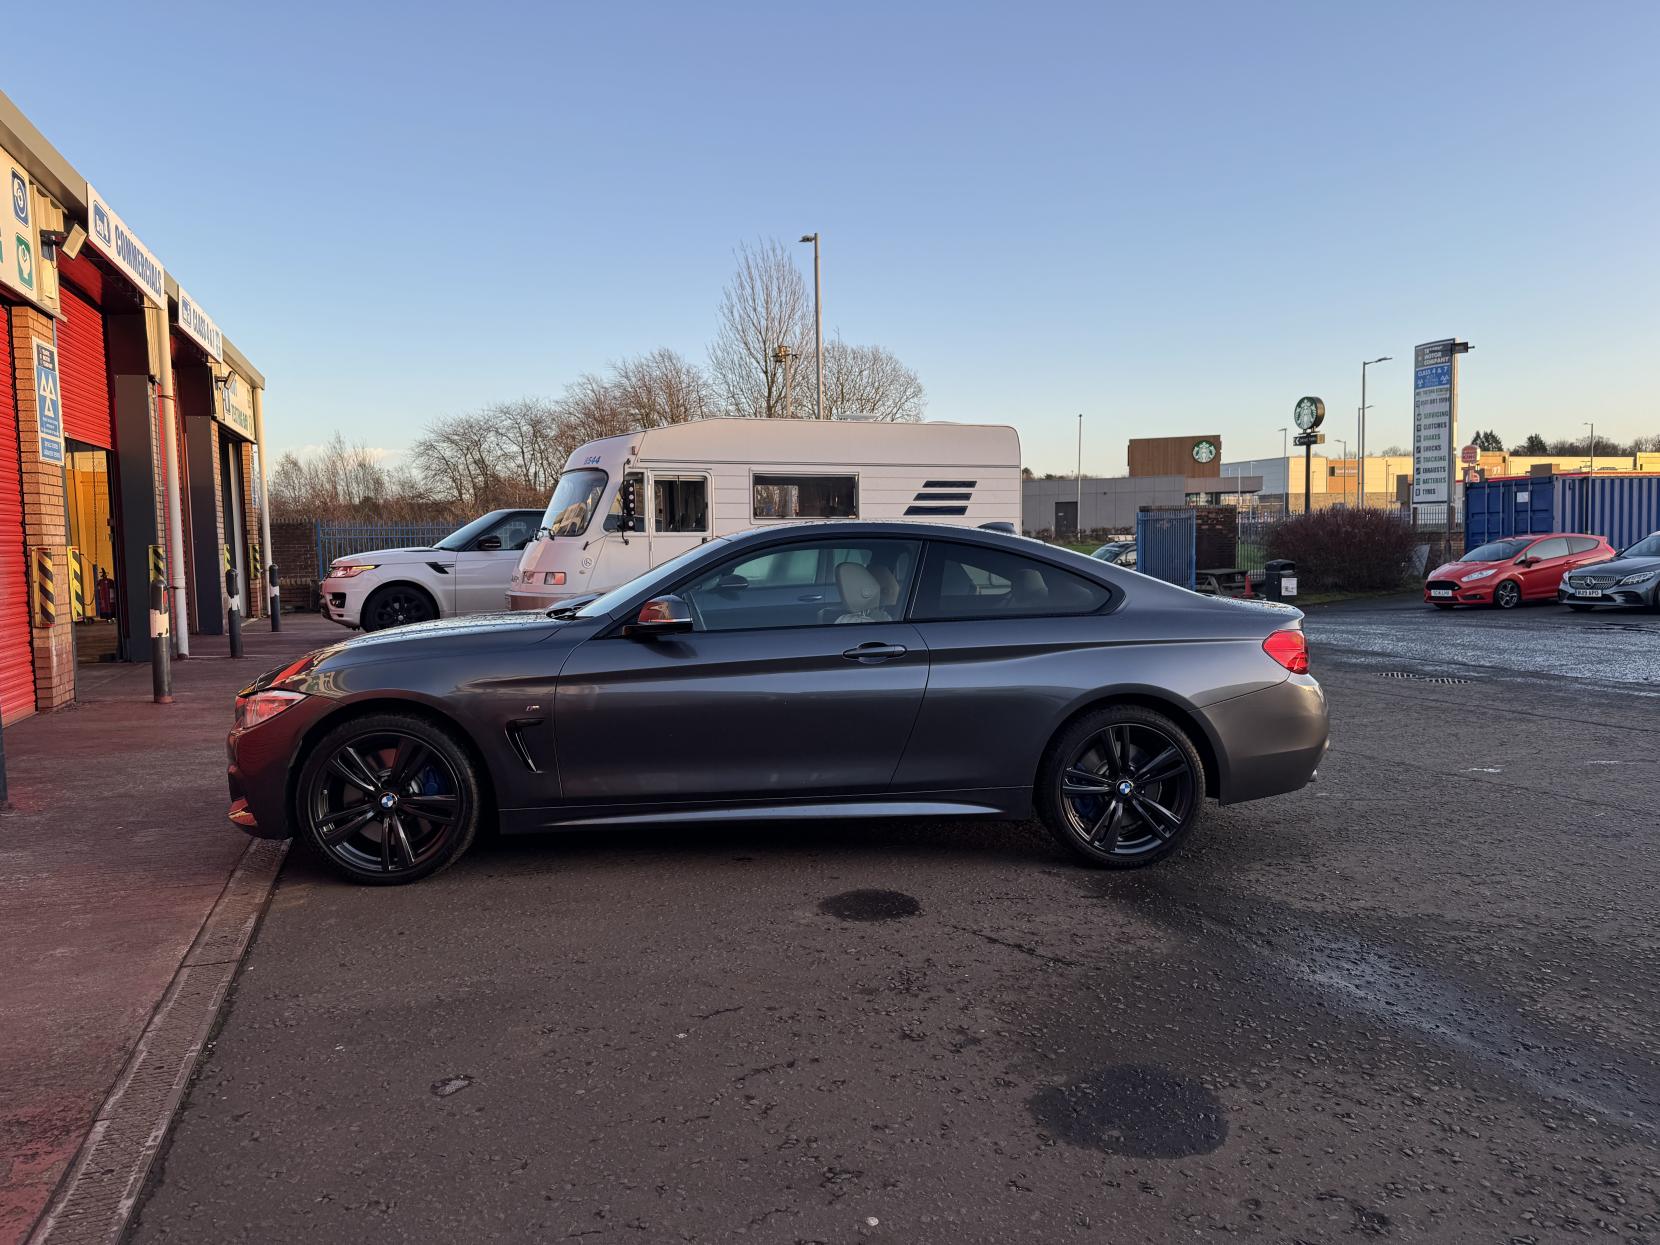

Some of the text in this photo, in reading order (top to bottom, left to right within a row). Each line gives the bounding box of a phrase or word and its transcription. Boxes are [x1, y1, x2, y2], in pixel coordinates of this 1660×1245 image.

[115, 224, 162, 297] COMMERCIALS
[1423, 356, 1449, 366] COMPANY
[1417, 369, 1431, 377] CLASS
[1423, 411, 1449, 419] SERVICING
[1423, 422, 1447, 430] CLUTCHES
[1422, 466, 1447, 474] EXHAUSTS
